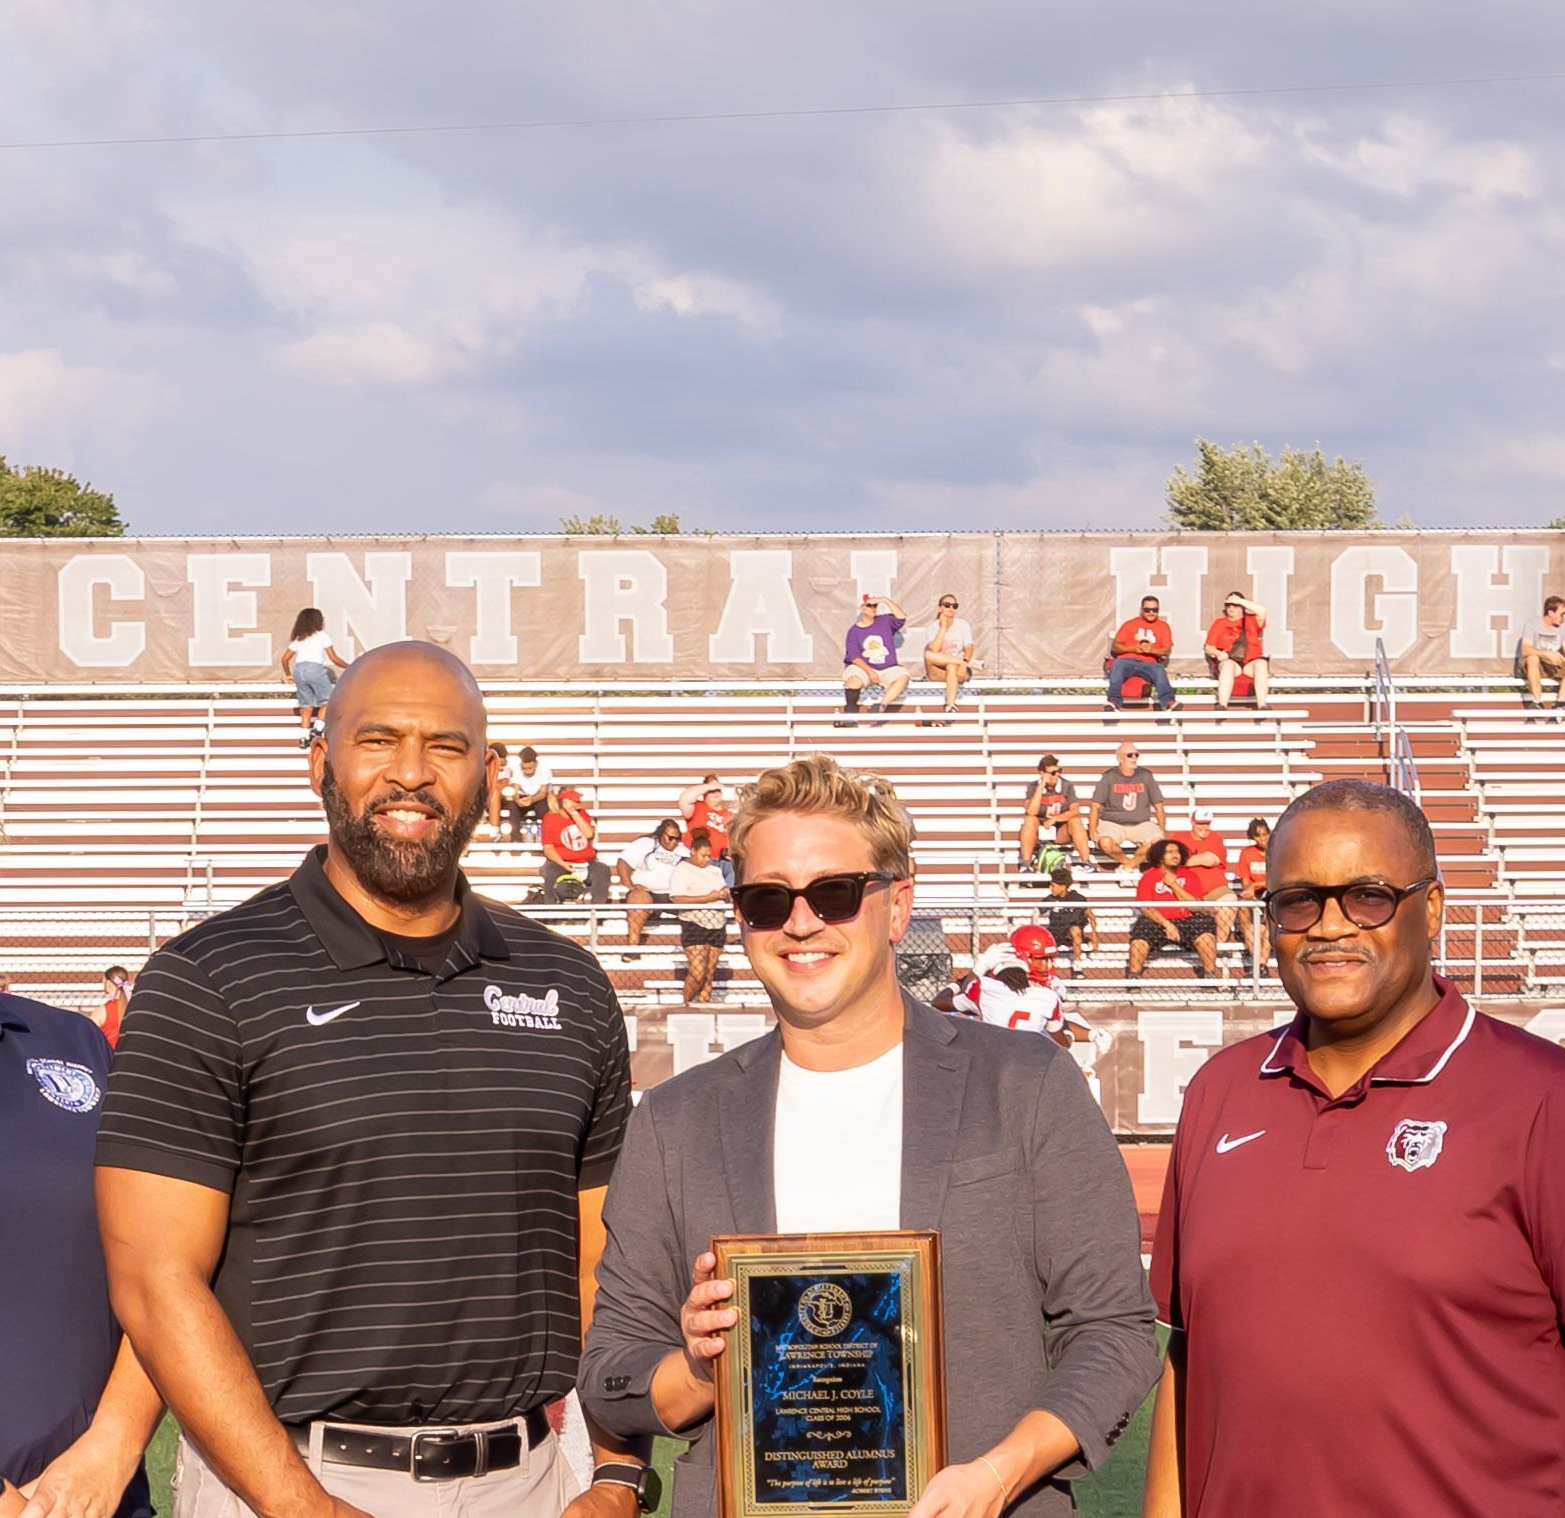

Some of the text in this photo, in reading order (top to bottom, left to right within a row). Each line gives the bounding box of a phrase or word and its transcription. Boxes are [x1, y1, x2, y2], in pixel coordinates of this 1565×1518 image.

[58, 550, 932, 668] CENTRAL
[1109, 545, 1550, 659] HIGH
[483, 984, 559, 1017] Central
[490, 1011, 563, 1030] FOOTBALL
[779, 1350, 874, 1361] LAWRENCE TOWNSHIP
[782, 1389, 875, 1402] MICHAEL J. COYLE
[764, 1449, 895, 1461] DISTINGUISHED ALUMNUS
[812, 1460, 848, 1469] AWARD
